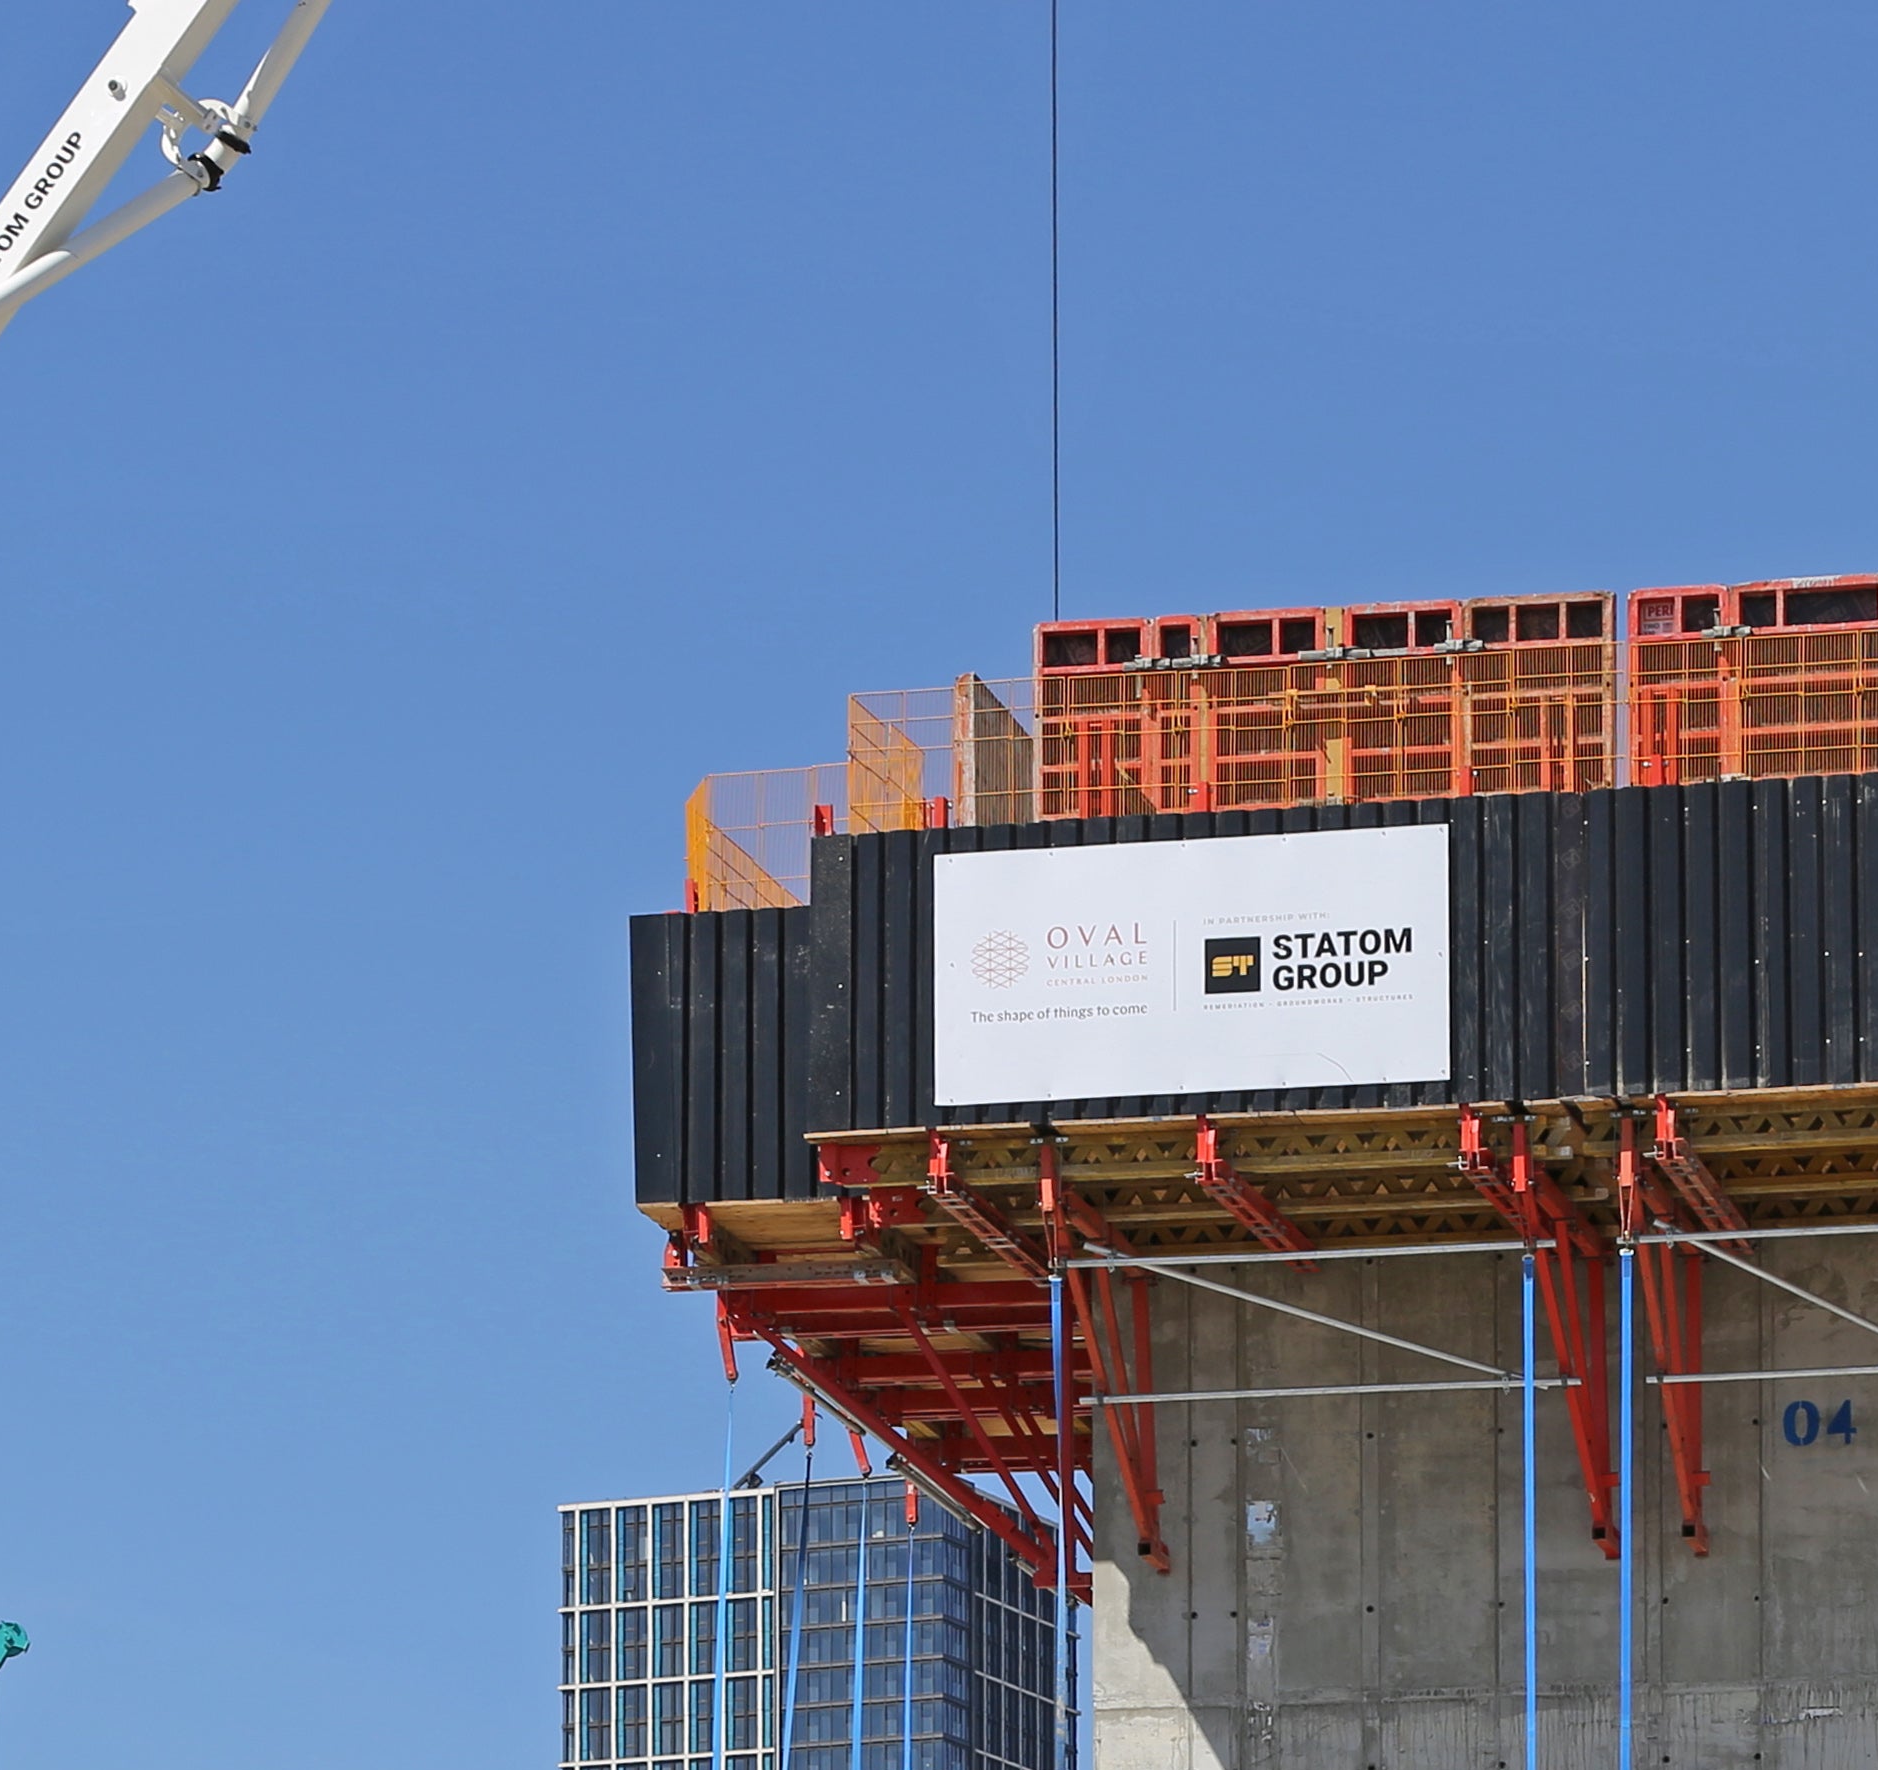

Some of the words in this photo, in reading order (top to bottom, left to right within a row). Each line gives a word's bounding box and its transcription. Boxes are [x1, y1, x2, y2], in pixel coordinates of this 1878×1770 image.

[24, 131, 82, 210] GROUP
[1203, 917, 1214, 925] IN
[1218, 914, 1294, 925] PARTNERSHIP
[1046, 922, 1148, 950] OVAL
[1272, 927, 1413, 961] STATOM
[1047, 951, 1148, 969] VILLAGE
[1046, 977, 1096, 987] CENTRAL
[1101, 974, 1149, 984] LONDON
[1272, 960, 1389, 991] GROUP
[970, 1011, 995, 1023] The
[997, 1009, 1034, 1023] shape
[1037, 1007, 1052, 1020] of
[1053, 1006, 1094, 1020] things
[1097, 1005, 1110, 1016] to
[1112, 1003, 1148, 1016] come
[1203, 1002, 1265, 1011] REMEDIATION
[1276, 997, 1343, 1007] GROUNDWORKS
[1356, 994, 1414, 1003] STRUCTURES
[1782, 1400, 1858, 1447] 04
